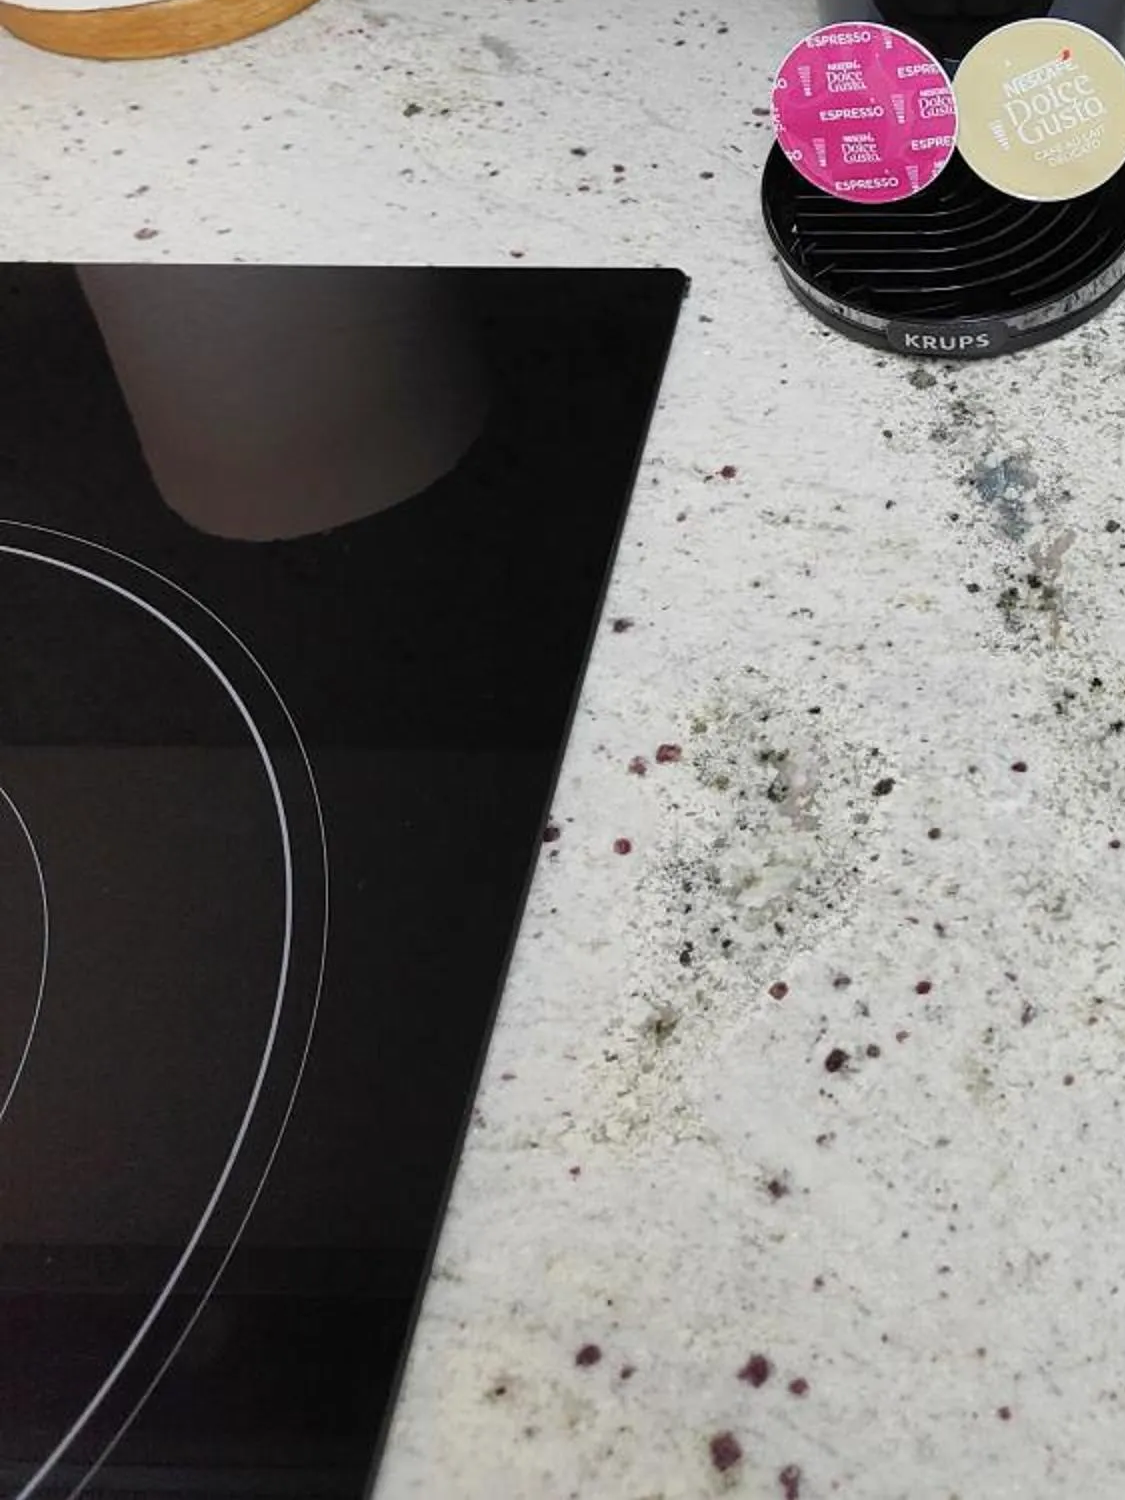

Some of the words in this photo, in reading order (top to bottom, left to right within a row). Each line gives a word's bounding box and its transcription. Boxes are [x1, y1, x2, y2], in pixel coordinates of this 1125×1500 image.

[806, 31, 871, 49] ESPRESSO
[1004, 75, 1096, 127] Dolce
[819, 105, 885, 121] ESPRESSO
[1017, 97, 1104, 145] Gusto
[835, 176, 899, 192] ESPRESSO
[904, 332, 991, 351] KRUPS
